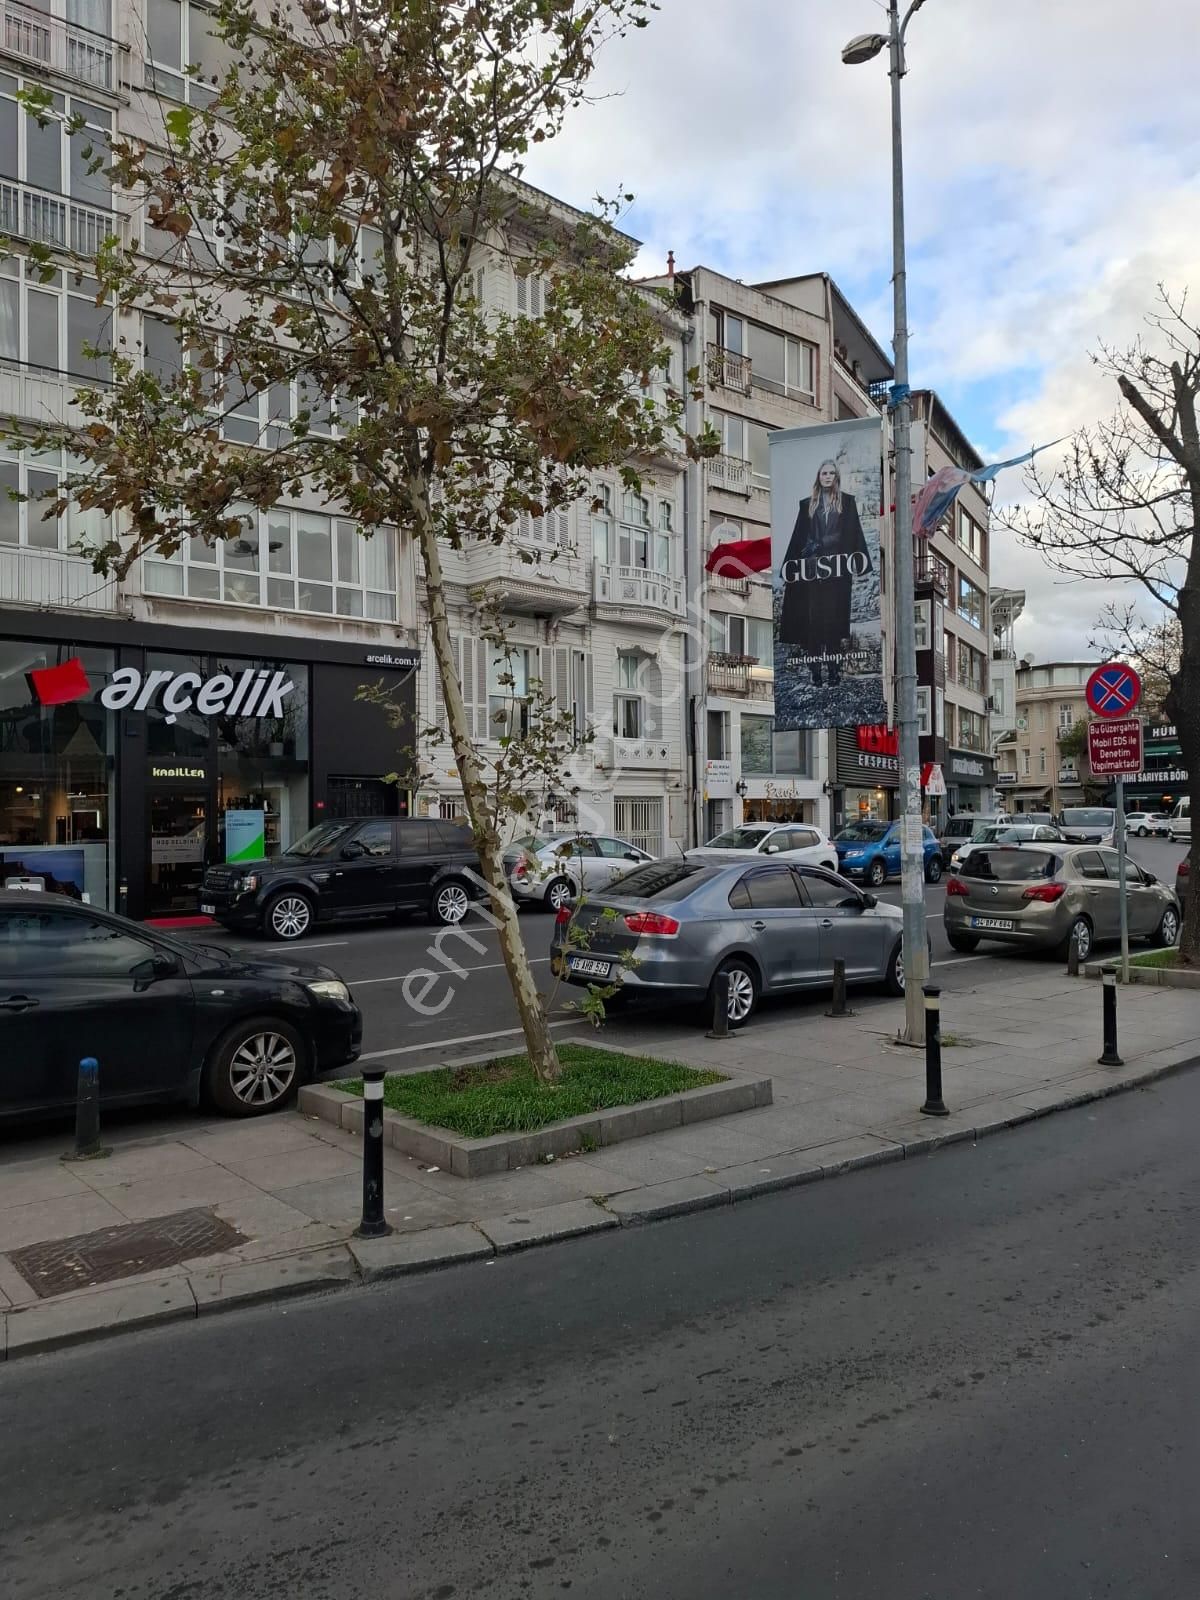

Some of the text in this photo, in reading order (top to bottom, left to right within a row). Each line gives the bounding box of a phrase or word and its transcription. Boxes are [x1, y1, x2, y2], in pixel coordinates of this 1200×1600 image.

[781, 551, 868, 583] GUSTO
[786, 650, 868, 669] gustoeshop.com
[101, 666, 295, 724] arçelik
[1090, 722, 1139, 735] Bu Güzergahta
[1092, 735, 1137, 748] Mobil EDS ile
[1100, 748, 1131, 759] Denetim
[1092, 758, 1140, 772] Yapılmaktadır
